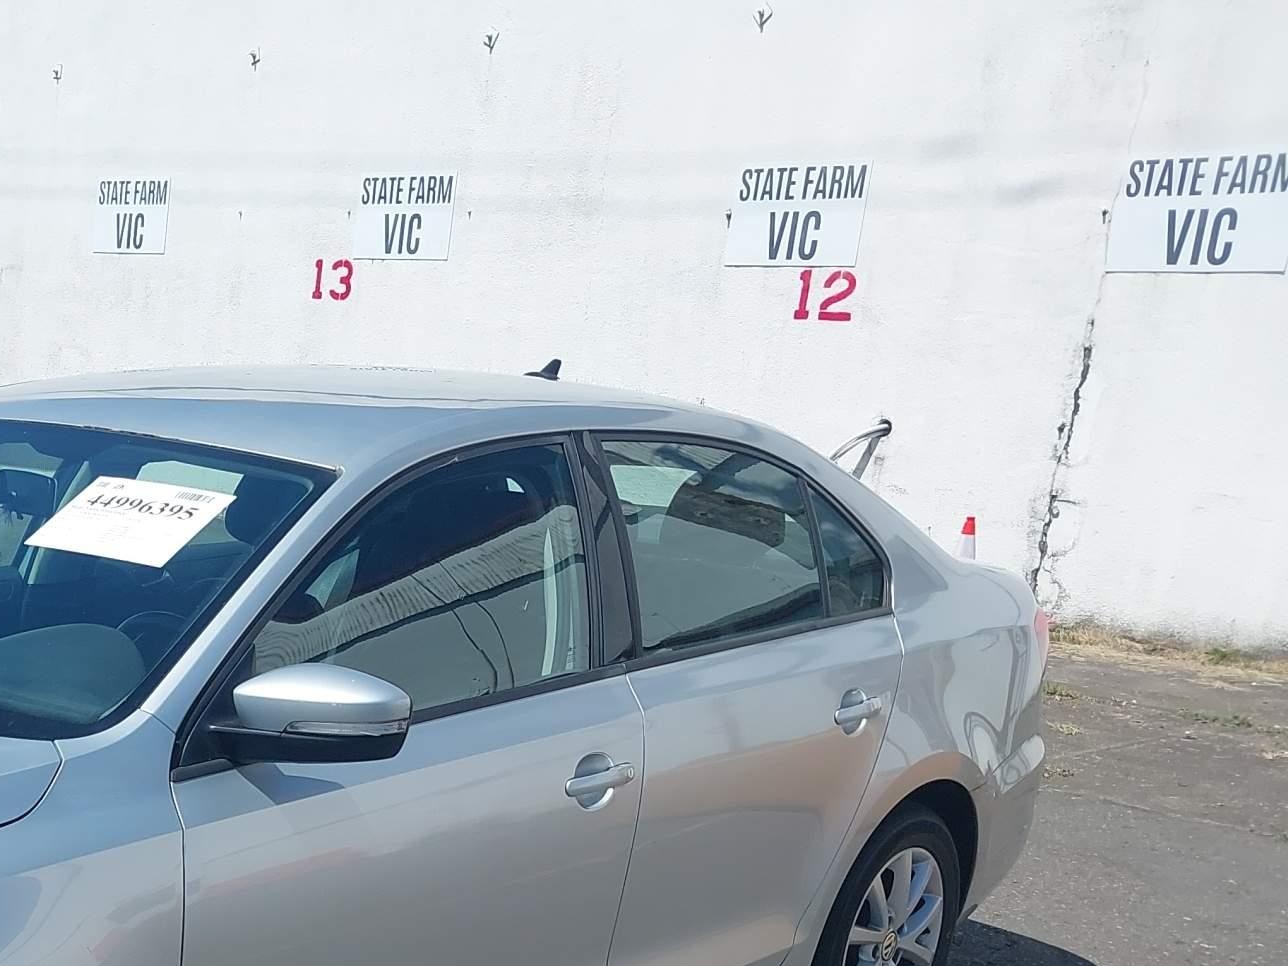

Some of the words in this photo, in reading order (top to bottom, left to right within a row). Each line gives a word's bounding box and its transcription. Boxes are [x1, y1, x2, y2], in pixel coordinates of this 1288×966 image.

[98, 180, 131, 206] STATE
[134, 180, 168, 205] FARM
[361, 177, 404, 205] STATE
[408, 175, 453, 204] FARM
[739, 167, 799, 202] STATE
[803, 164, 868, 199] FARM
[1126, 158, 1208, 197] STATE
[115, 213, 145, 249] VIC
[383, 213, 422, 255] VIC
[767, 210, 822, 261] VIC
[1165, 207, 1238, 266] VIC
[312, 258, 354, 300] 13
[793, 269, 857, 321] 12
[88, 494, 199, 520] 44996395
